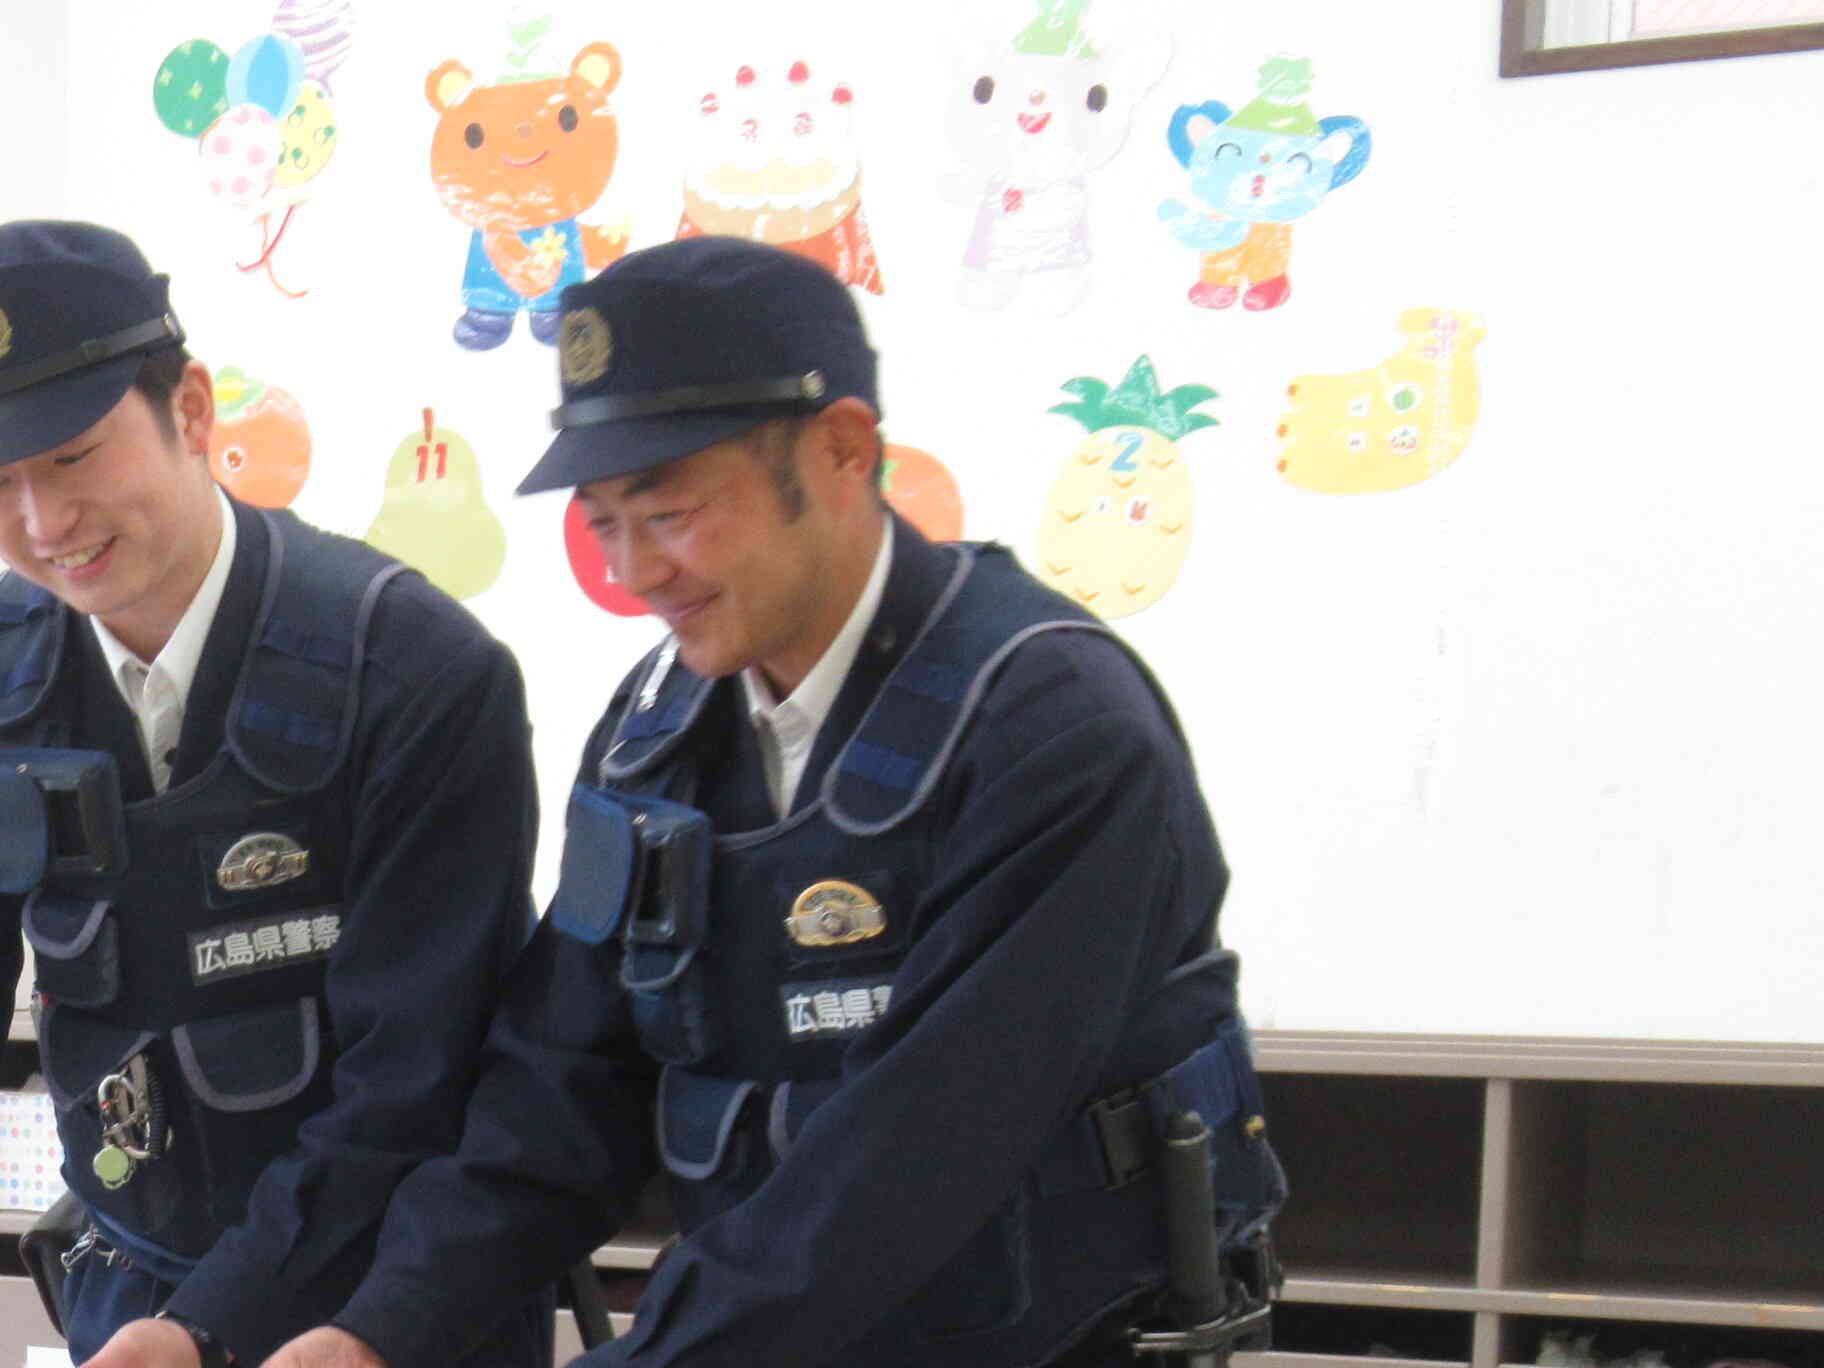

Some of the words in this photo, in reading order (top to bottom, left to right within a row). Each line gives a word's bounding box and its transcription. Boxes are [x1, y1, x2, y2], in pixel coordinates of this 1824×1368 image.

[416, 443, 448, 484] 11
[1109, 431, 1144, 471] 2
[194, 914, 342, 976] 広島県警察
